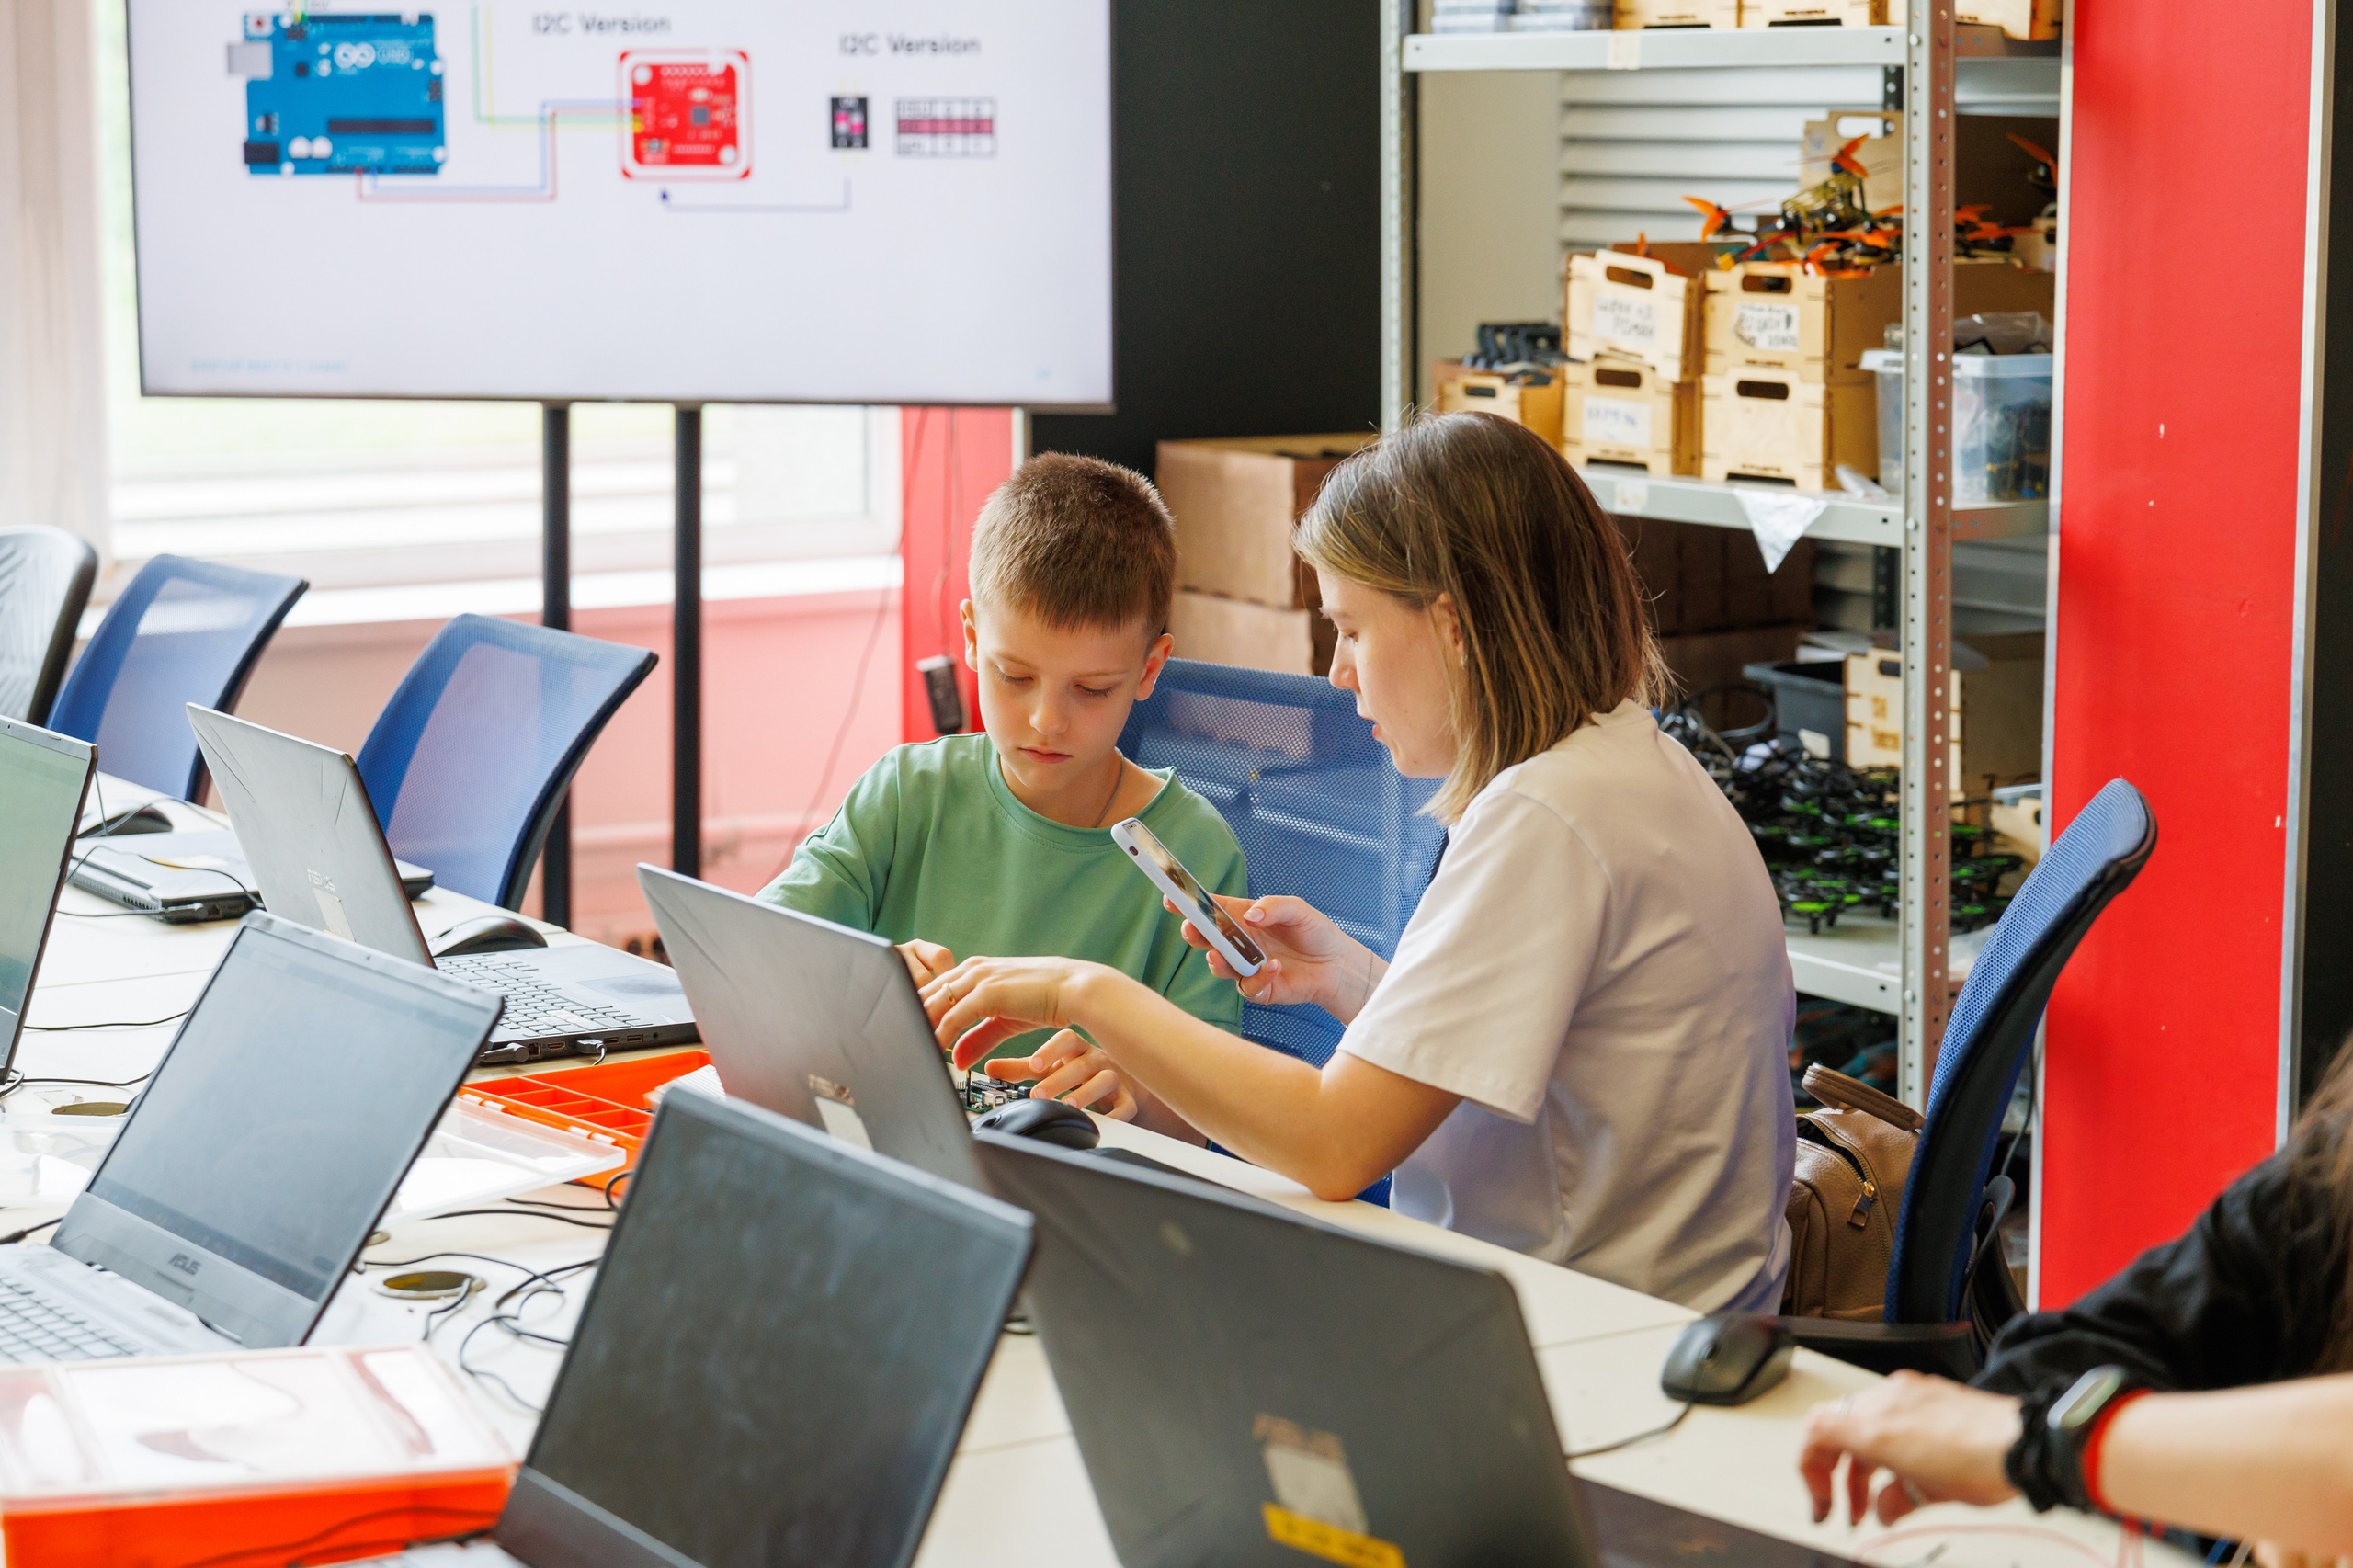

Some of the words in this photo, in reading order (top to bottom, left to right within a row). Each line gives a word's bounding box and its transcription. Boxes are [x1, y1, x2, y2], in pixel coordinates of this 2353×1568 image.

[532, 11, 572, 35] I2C
[578, 11, 672, 34] Version
[885, 32, 982, 56] Version
[168, 1253, 201, 1276] ASUS
